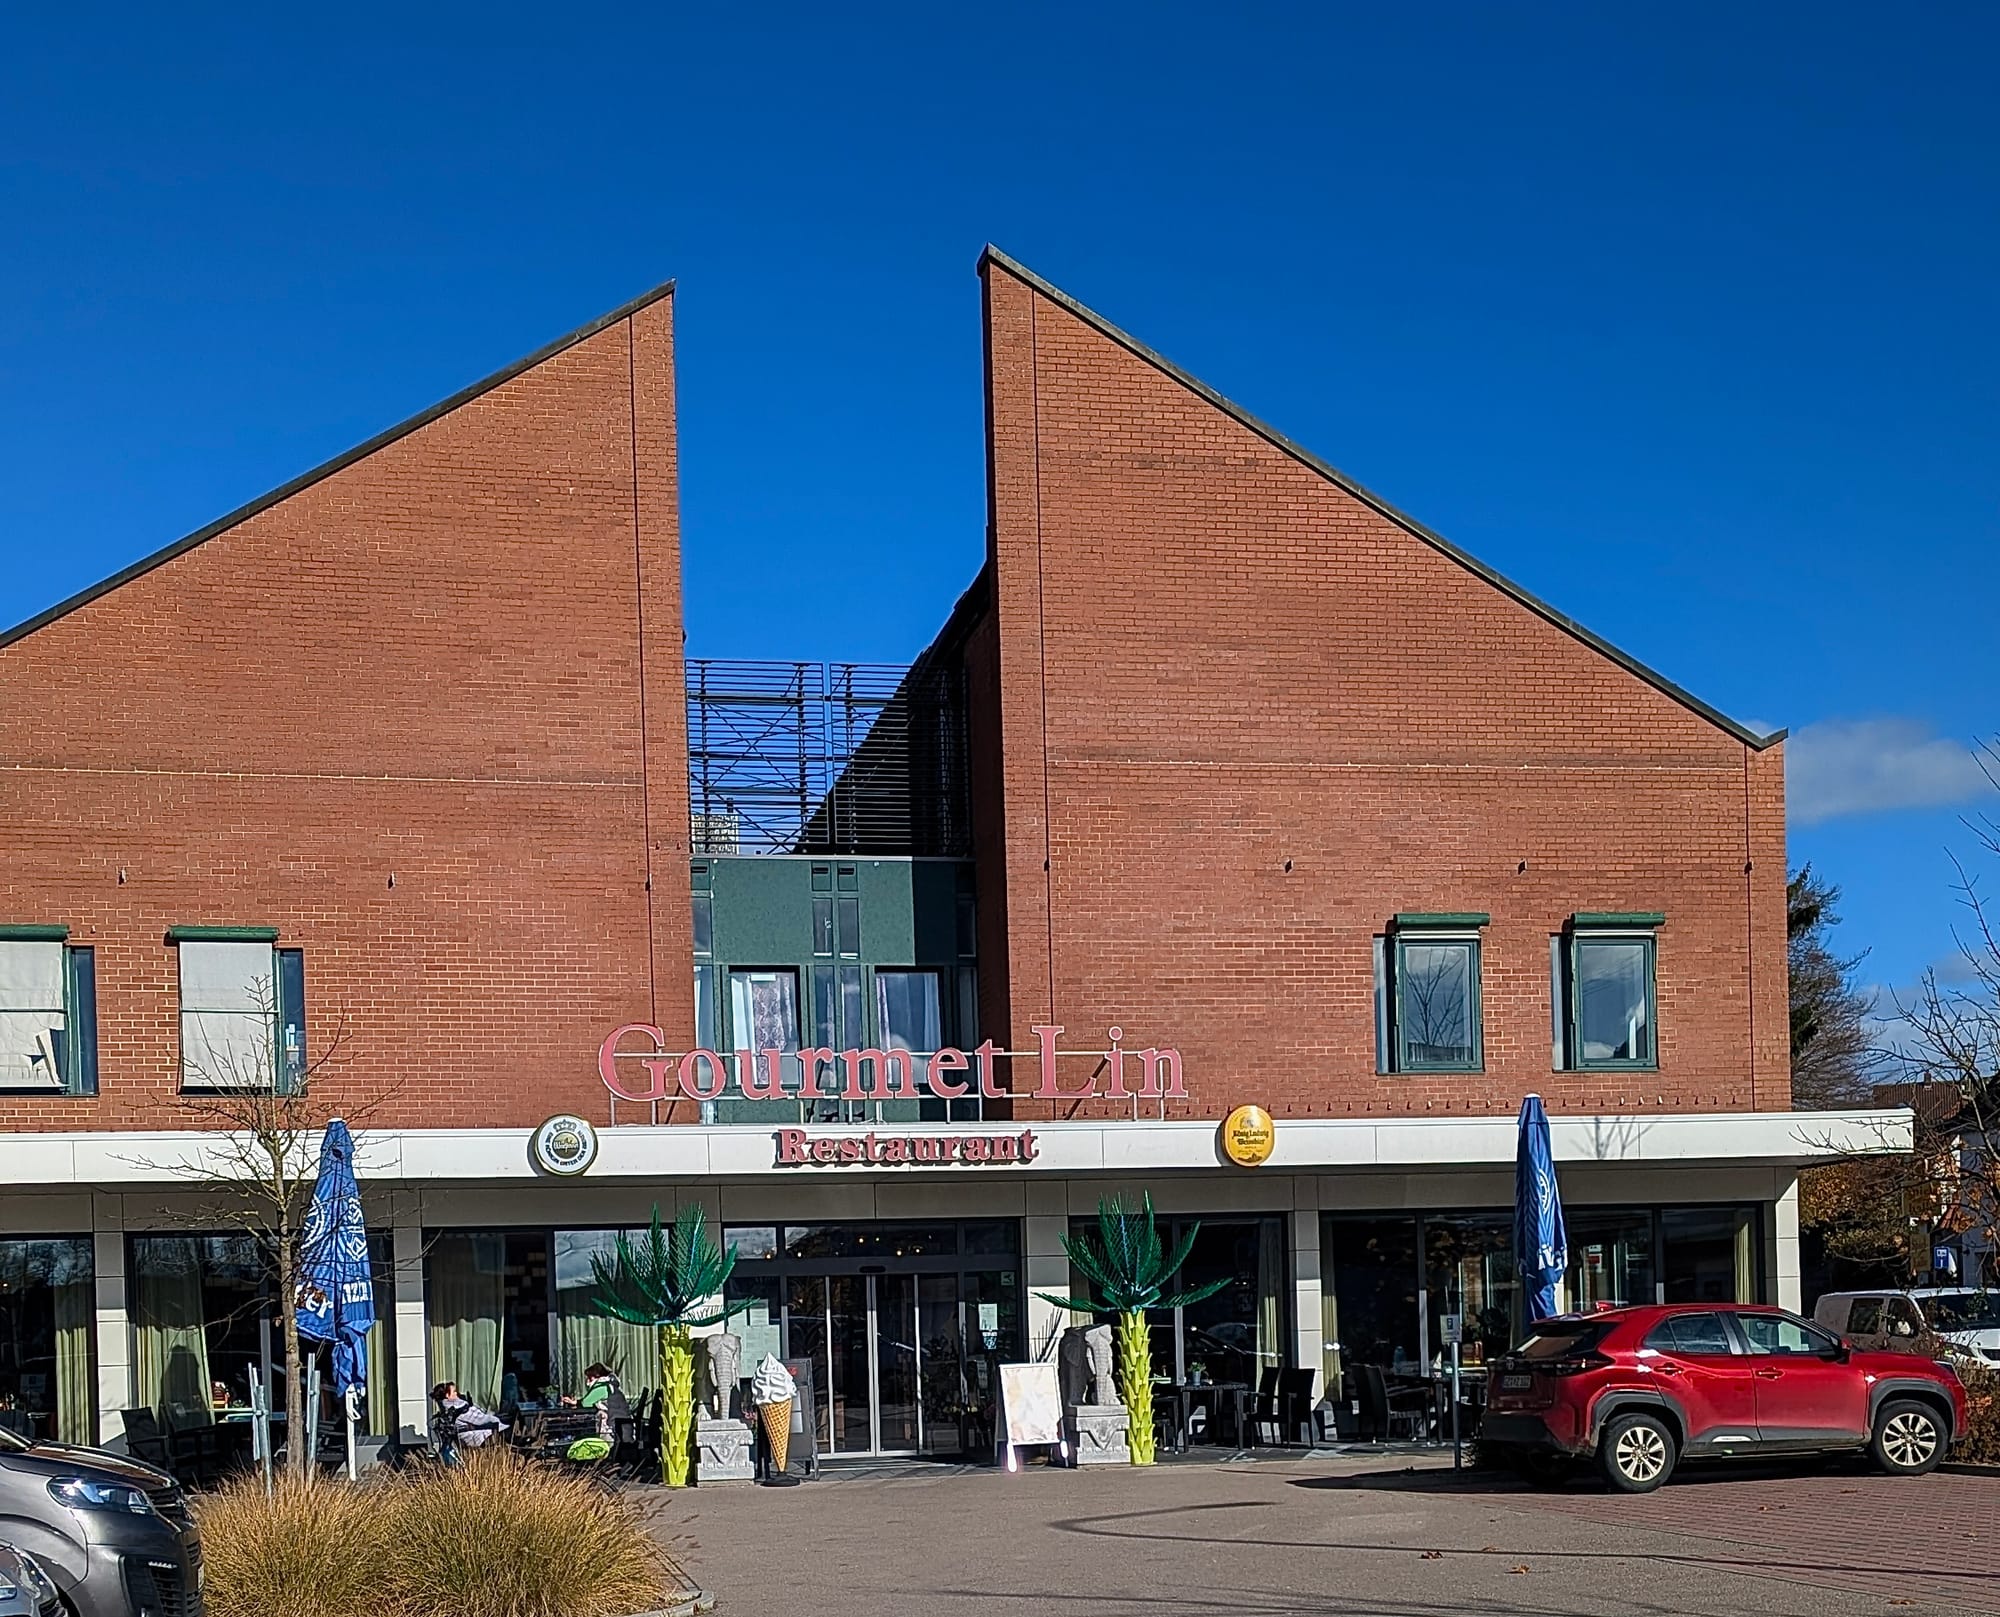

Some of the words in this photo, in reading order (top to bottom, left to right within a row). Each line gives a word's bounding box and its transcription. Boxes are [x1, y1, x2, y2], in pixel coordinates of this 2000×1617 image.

[598, 1023, 1007, 1101] Gourmet
[1031, 1025, 1189, 1100] Lin
[776, 1128, 1038, 1164] Restaurant
